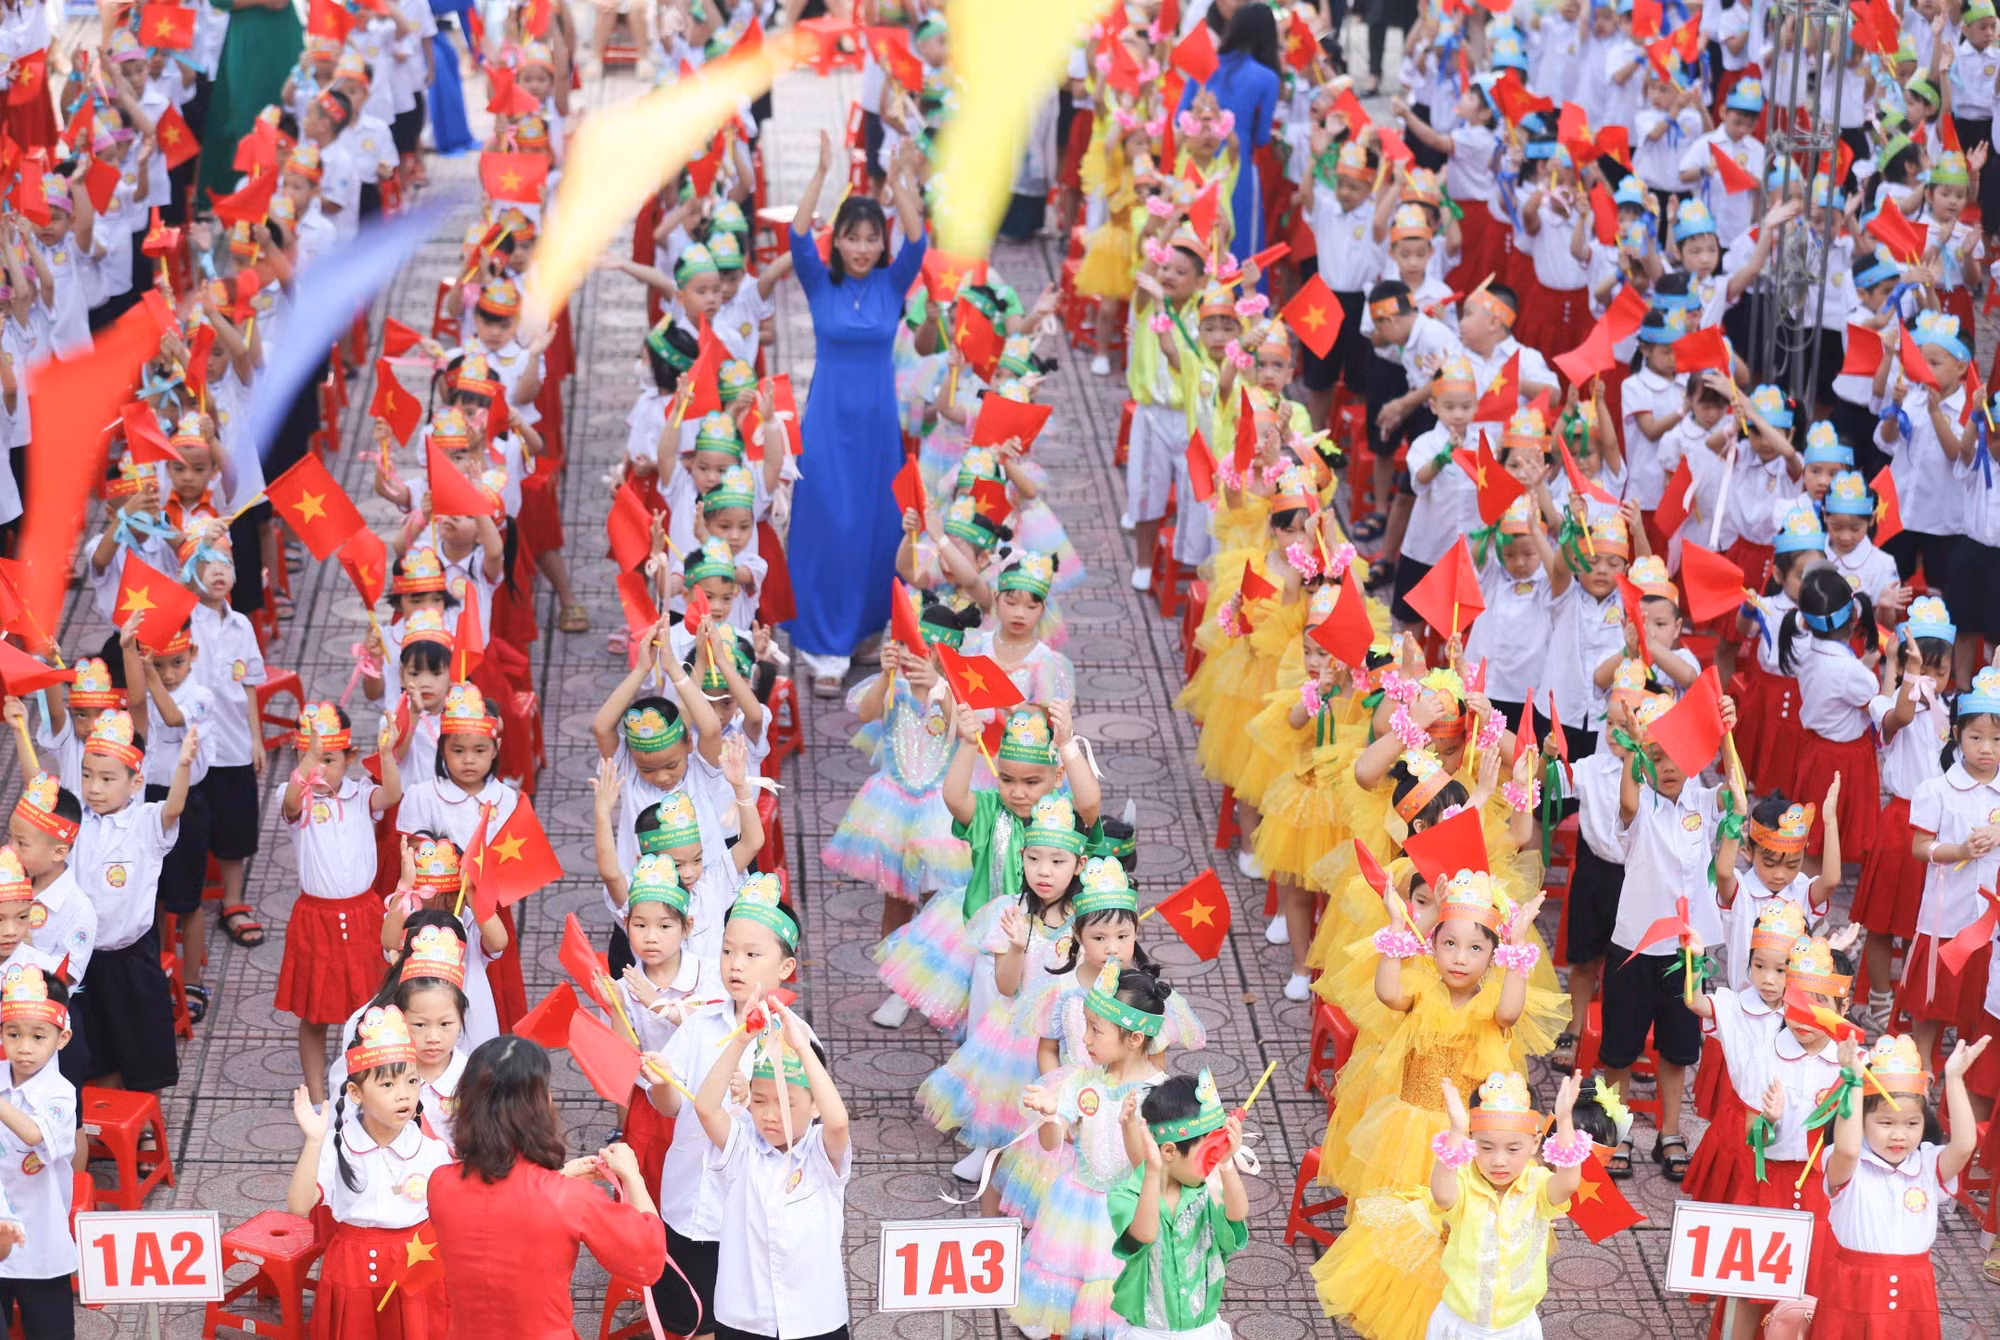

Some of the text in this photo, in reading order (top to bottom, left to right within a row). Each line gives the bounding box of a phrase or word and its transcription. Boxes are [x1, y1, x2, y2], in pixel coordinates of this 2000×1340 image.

[93, 1231, 206, 1287] 1A2
[896, 1239, 1005, 1296] 1A3
[1687, 1225, 1793, 1284] 1A4
